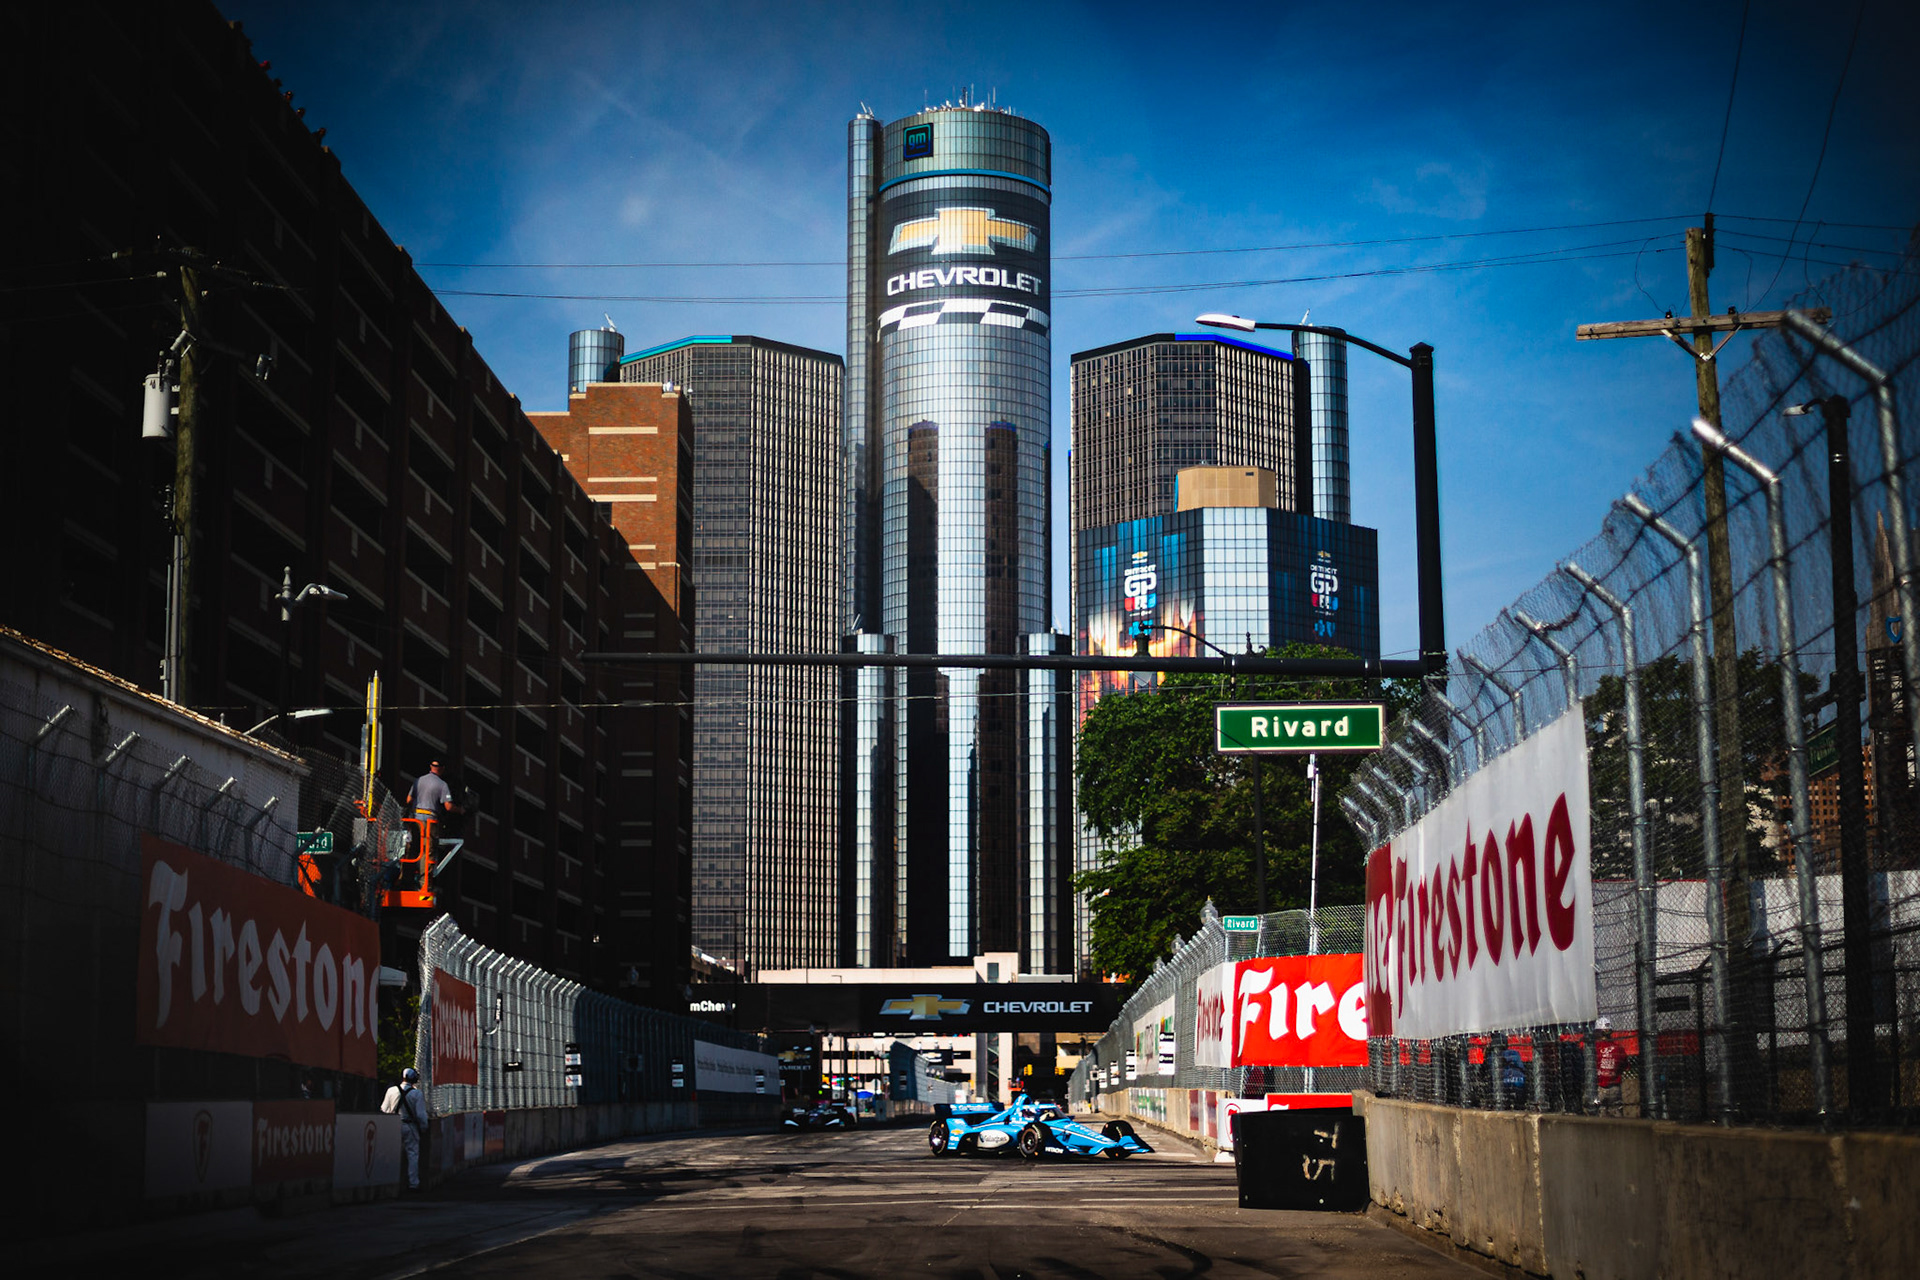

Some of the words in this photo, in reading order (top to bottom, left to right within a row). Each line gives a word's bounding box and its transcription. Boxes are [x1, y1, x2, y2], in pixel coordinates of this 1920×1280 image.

[908, 131, 926, 149] gm
[887, 266, 1042, 296] CHEVROLET
[1124, 572, 1157, 598] GP
[1311, 572, 1339, 595] GP
[1251, 715, 1349, 738] Rivard
[1393, 792, 1576, 1019] Firestone
[1227, 919, 1255, 929] Rivard
[983, 1001, 1093, 1014] CHEVROLET
[256, 1117, 333, 1168] Firestone
